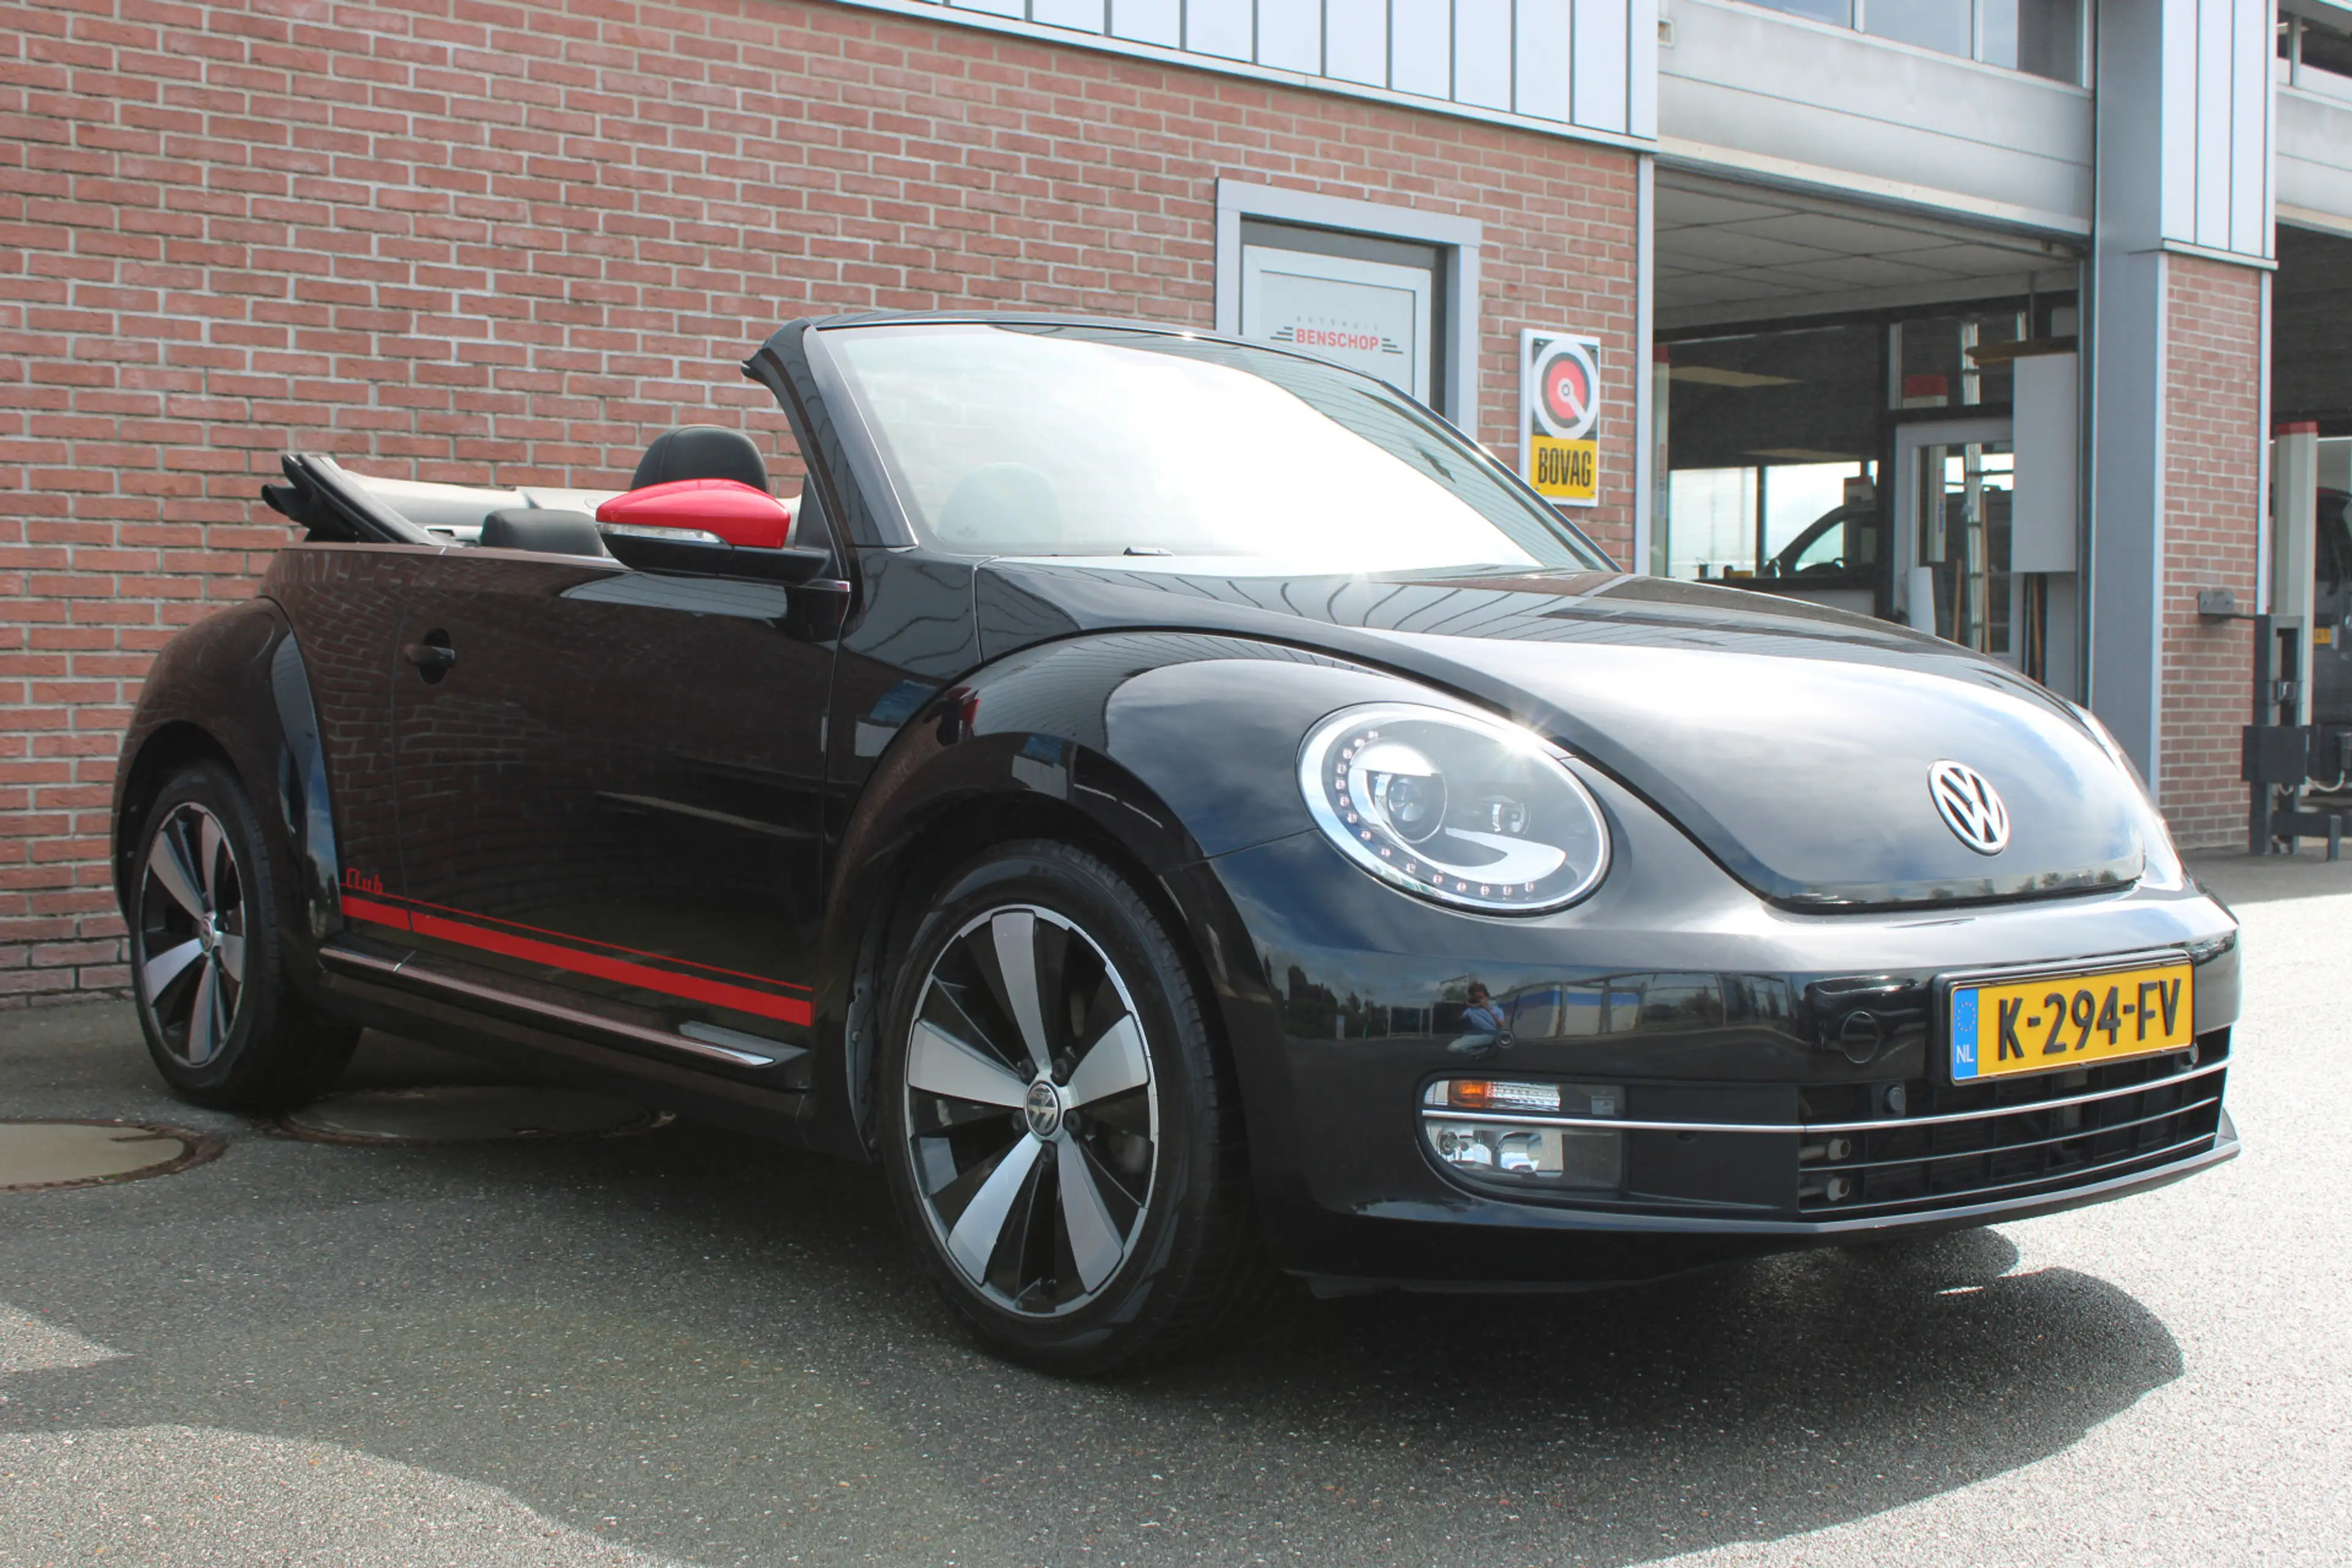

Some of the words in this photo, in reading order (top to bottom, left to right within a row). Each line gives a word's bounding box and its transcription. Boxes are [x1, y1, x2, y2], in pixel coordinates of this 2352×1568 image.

[1295, 328, 1379, 351] BENSCHOP
[1538, 447, 1592, 488] BOVAG
[1998, 978, 2181, 1061] K-294-FV
[1956, 1044, 1975, 1064] NL
